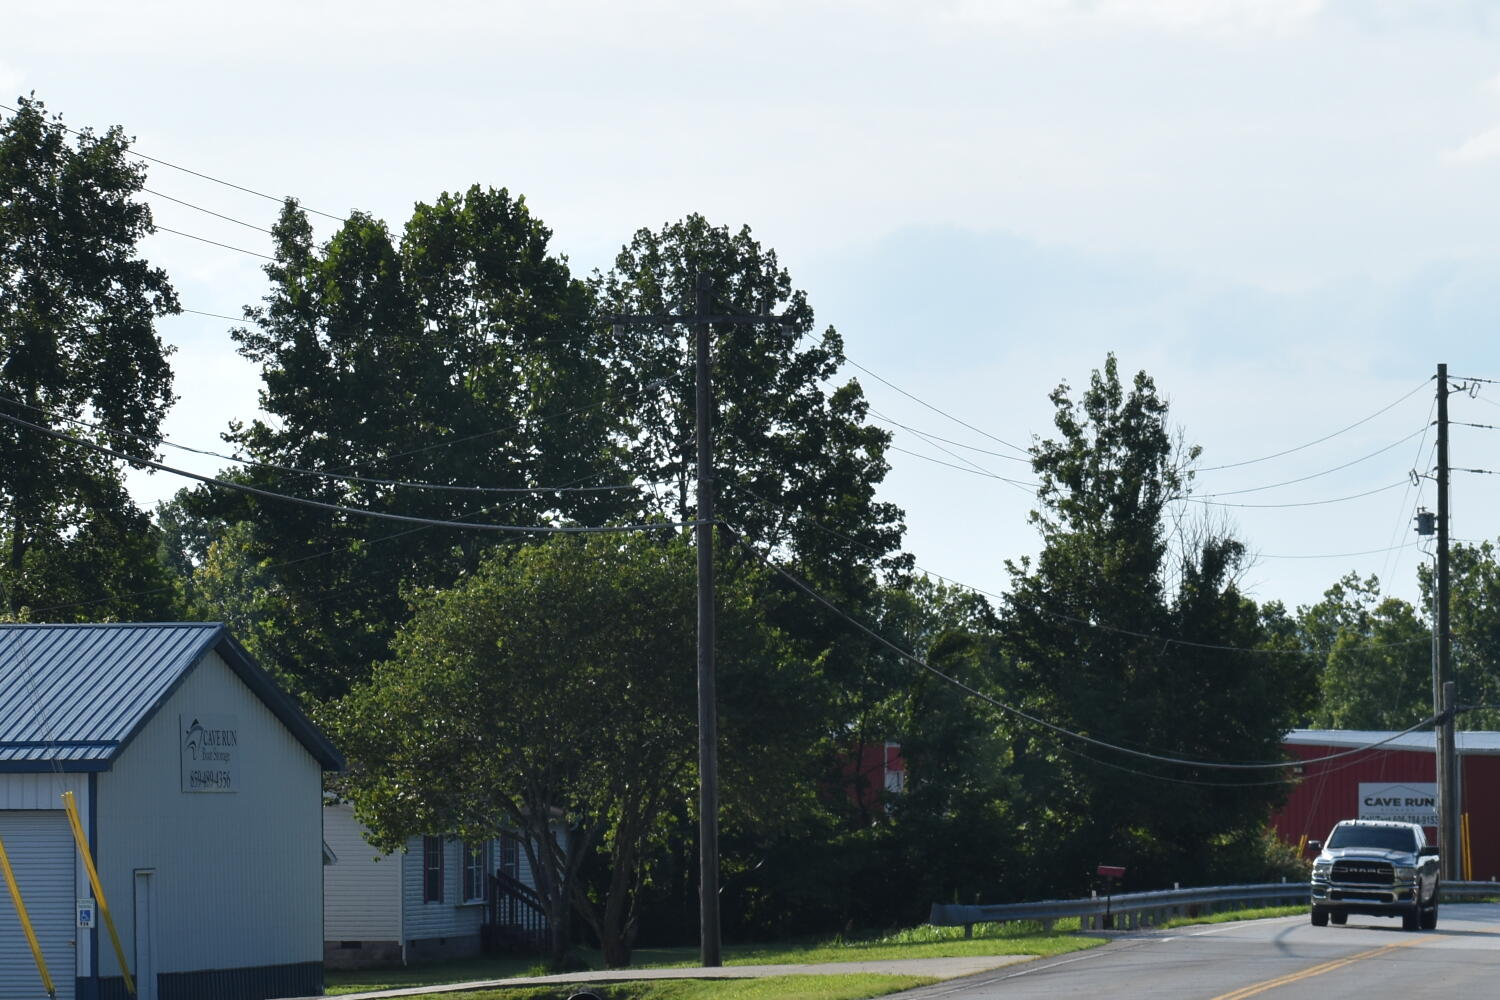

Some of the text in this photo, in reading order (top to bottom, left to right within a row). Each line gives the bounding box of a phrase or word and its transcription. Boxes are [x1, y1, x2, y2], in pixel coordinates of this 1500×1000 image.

[203, 729, 238, 746] CAVE RUN
[1364, 797, 1435, 807] CAVE RUN
